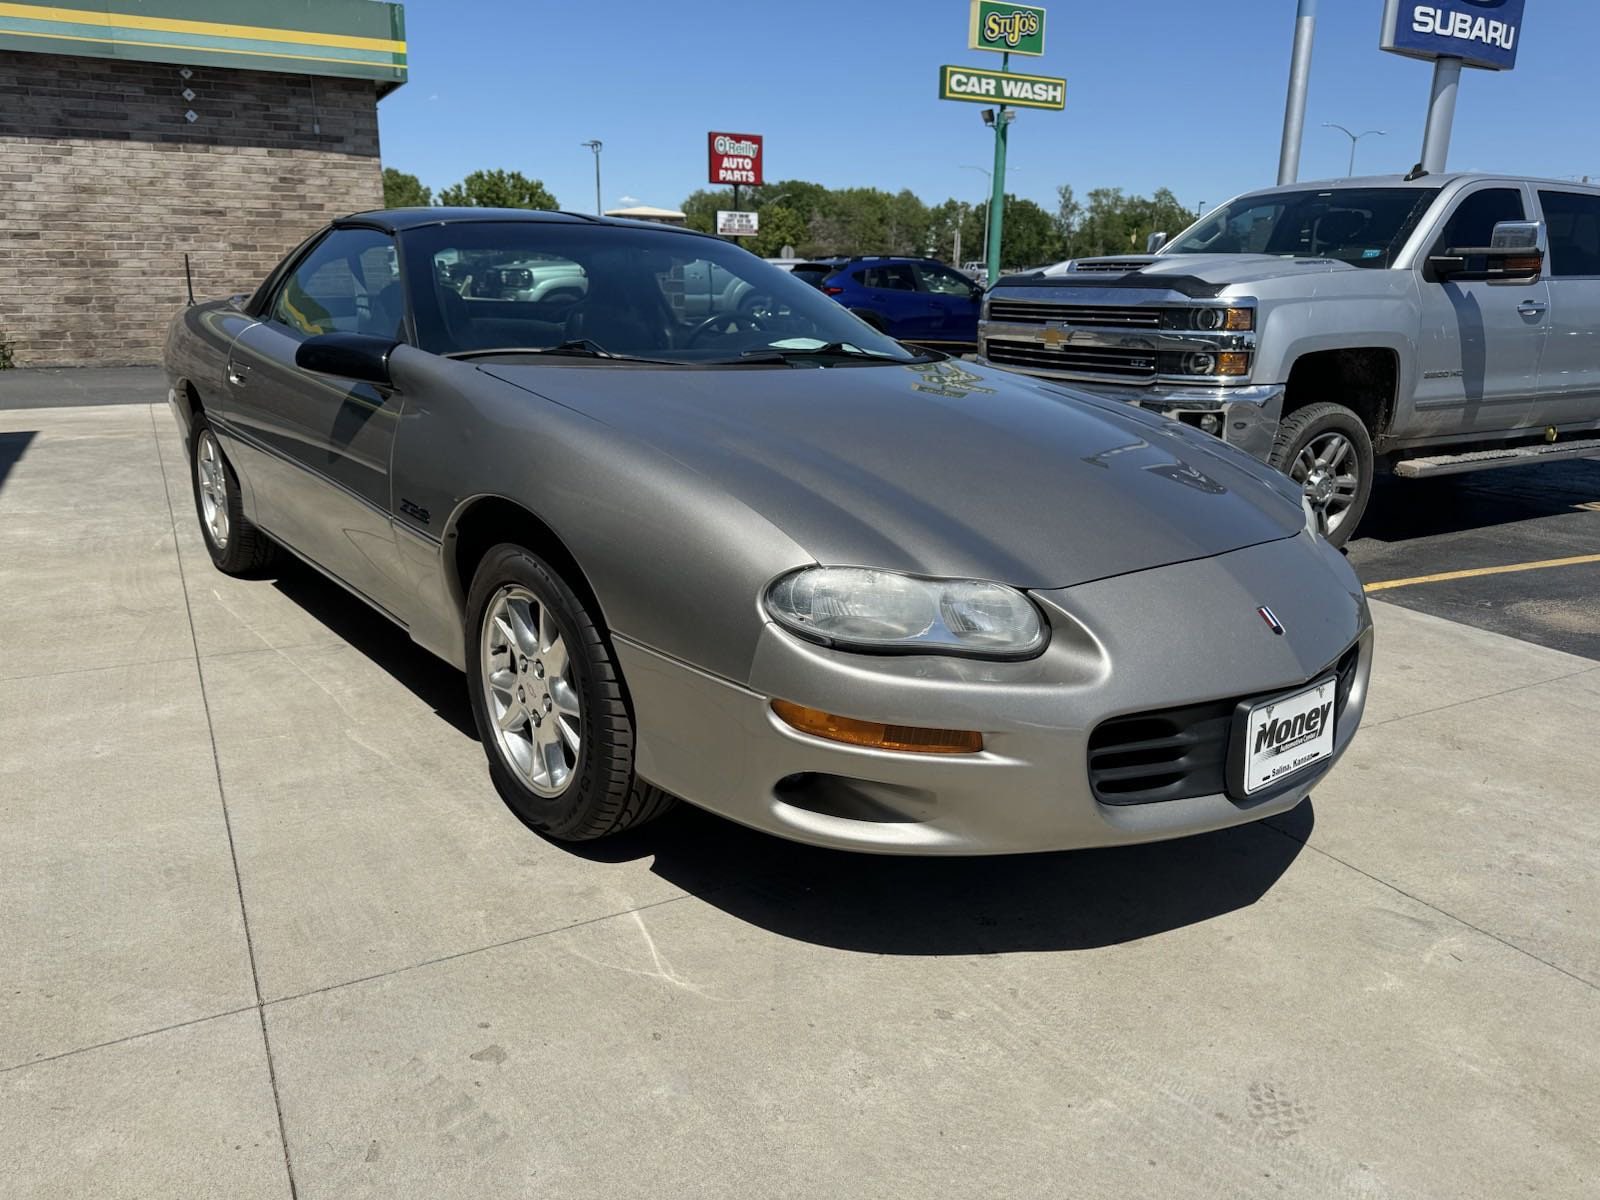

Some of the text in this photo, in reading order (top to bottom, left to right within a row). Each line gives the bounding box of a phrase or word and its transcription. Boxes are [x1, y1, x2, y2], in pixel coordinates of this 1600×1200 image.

[1412, 5, 1515, 50] SUBARU
[950, 74, 1062, 103] CAR WASH
[714, 136, 758, 159] O'Reilly
[722, 157, 752, 170] AUTO
[719, 169, 755, 183] PARTS
[1254, 701, 1332, 755] Money
[1272, 764, 1291, 777] Salina,
